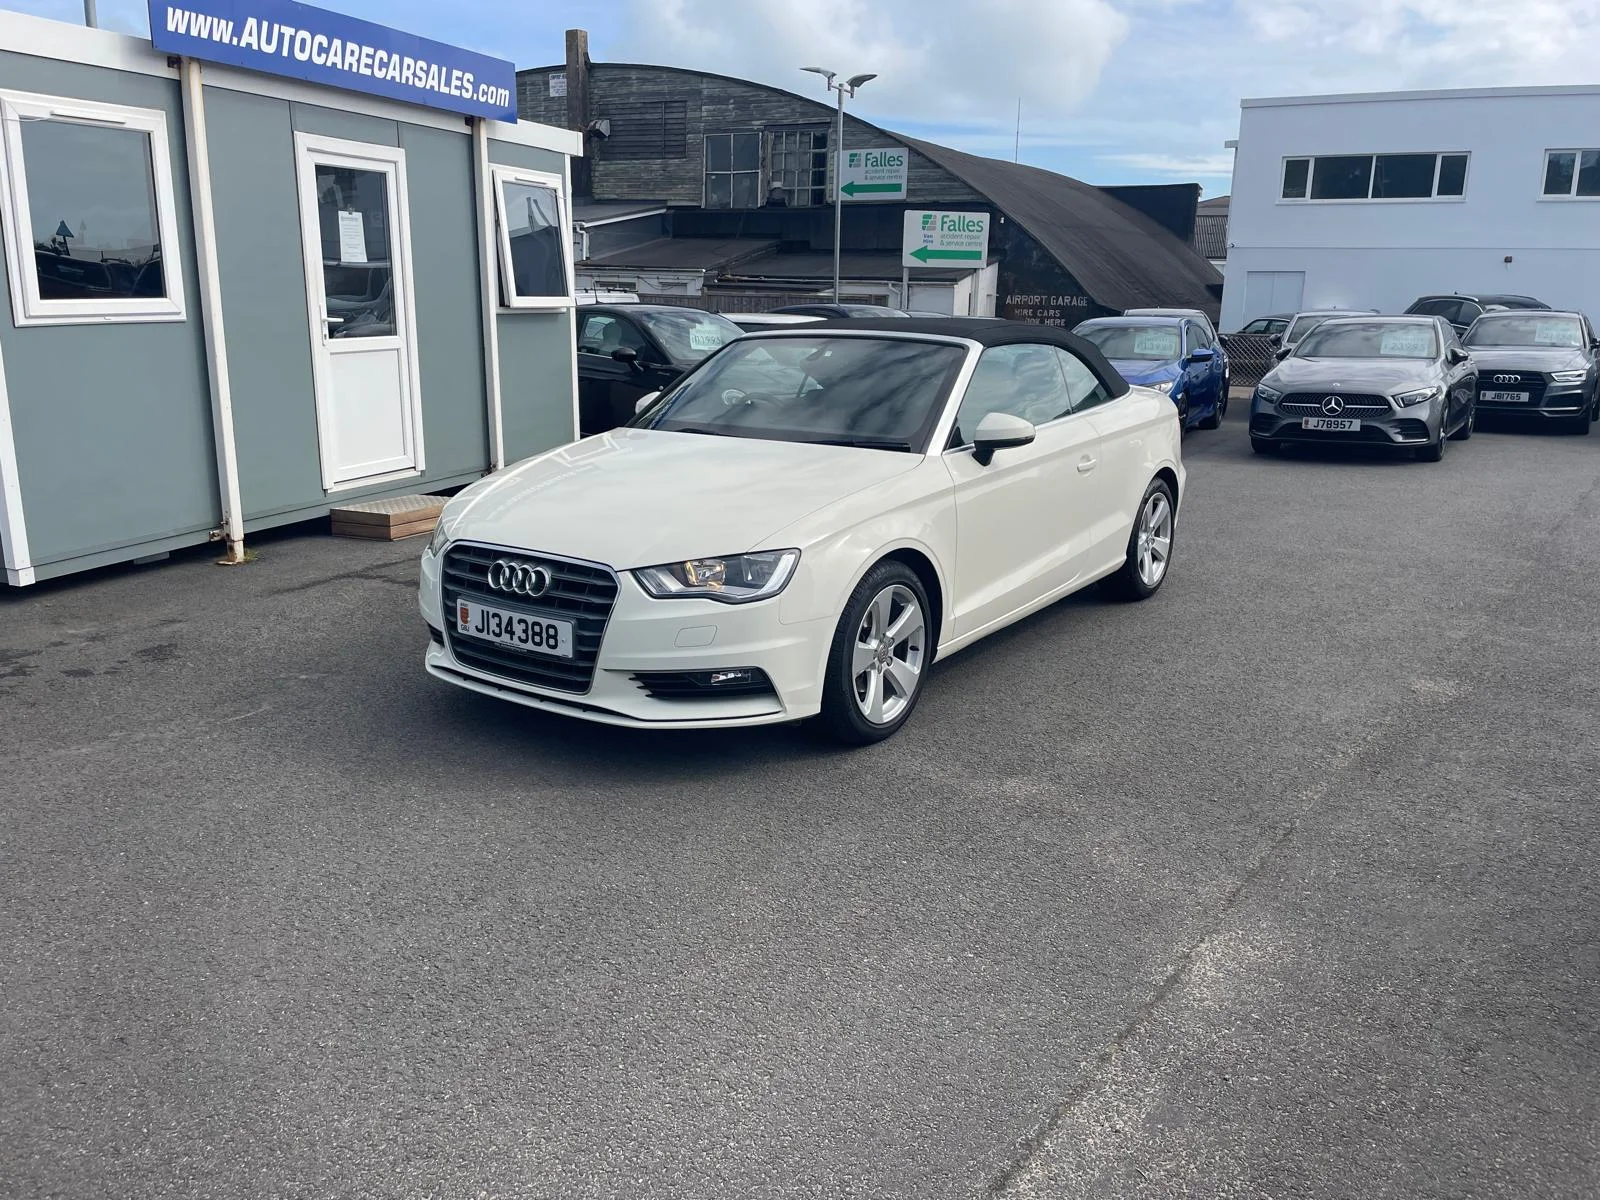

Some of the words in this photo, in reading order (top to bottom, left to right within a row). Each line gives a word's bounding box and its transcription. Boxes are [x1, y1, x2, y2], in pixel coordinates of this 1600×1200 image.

[166, 7, 510, 108] www.AUTOCARECARSALES.com
[864, 151, 904, 168] Falles
[940, 214, 984, 233] Falles
[1005, 294, 1048, 305] AIRPORT
[1050, 295, 1088, 307] GARAGE
[1037, 309, 1061, 317] CARS
[1044, 318, 1066, 327] HERE
[1313, 419, 1354, 430] J78957
